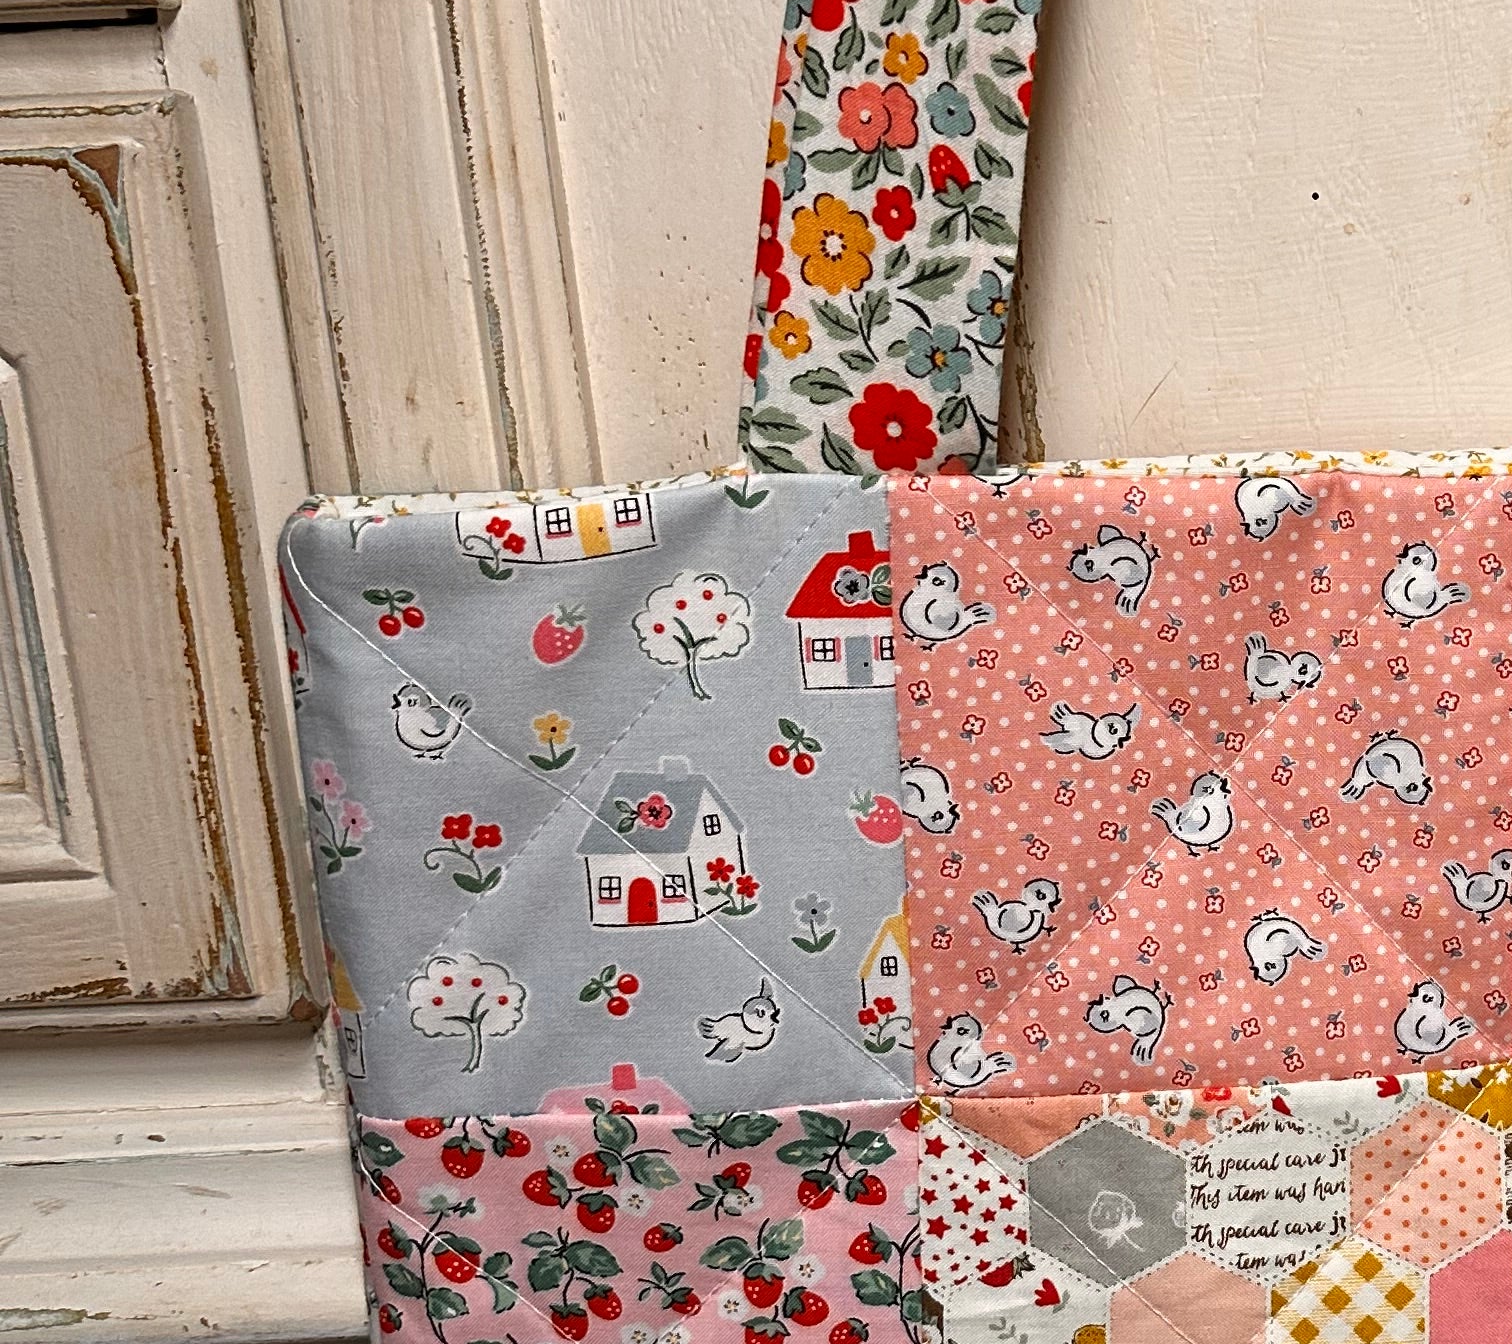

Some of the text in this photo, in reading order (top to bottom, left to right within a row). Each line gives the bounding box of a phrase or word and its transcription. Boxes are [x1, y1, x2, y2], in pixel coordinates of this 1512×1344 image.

[1217, 1152, 1280, 1180] special
[1285, 1152, 1327, 1168] care
[1190, 1182, 1221, 1210] This
[1228, 1184, 1270, 1202] item
[1274, 1182, 1306, 1203] was
[1217, 1219, 1280, 1250] special
[1285, 1220, 1327, 1235] care
